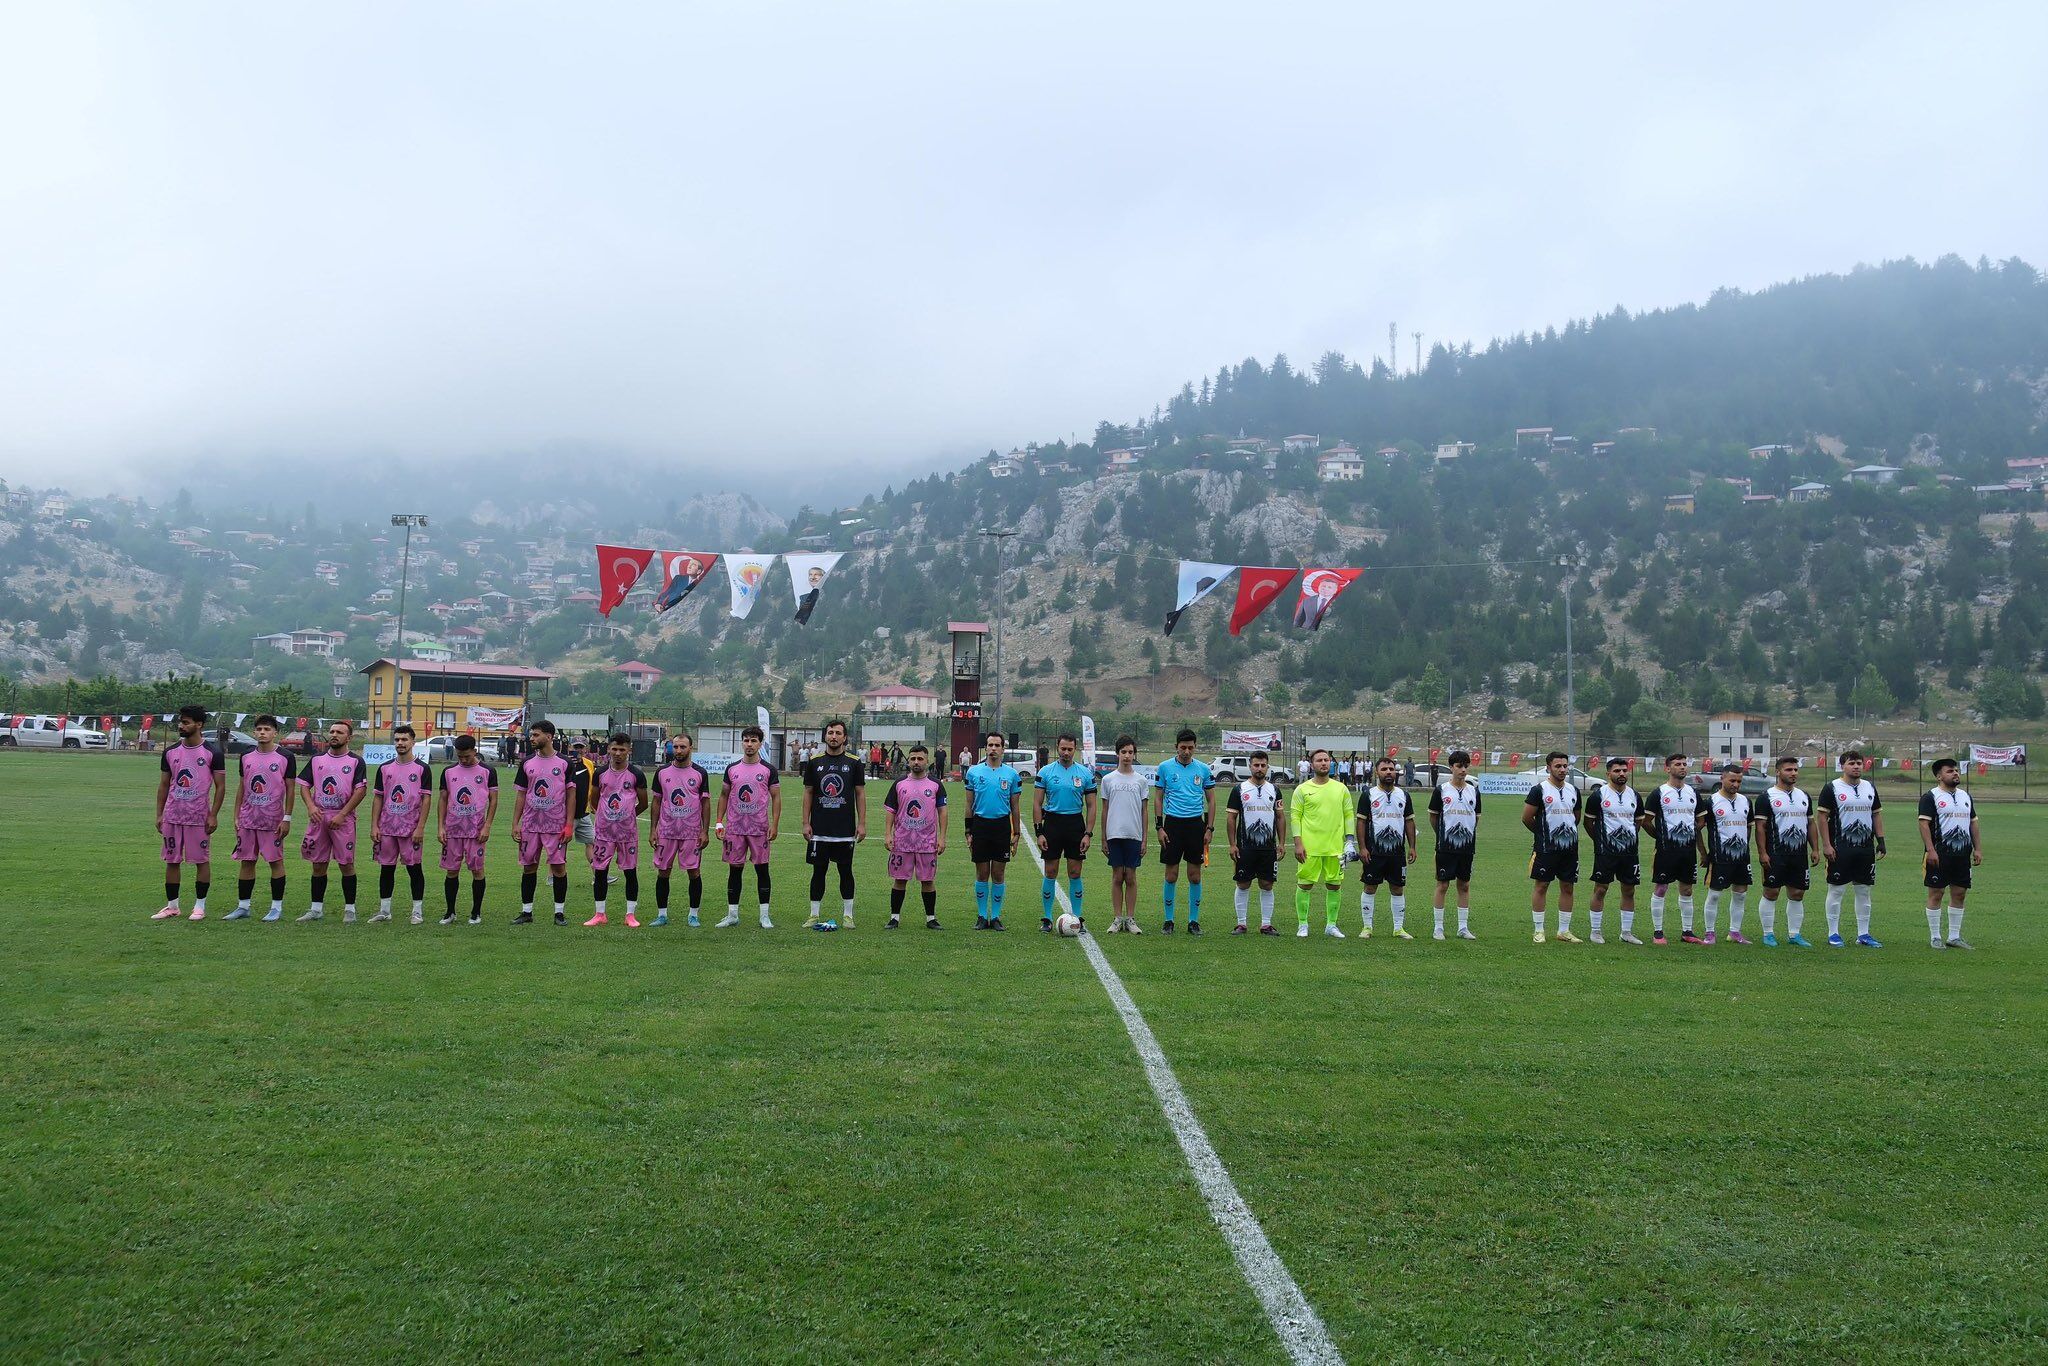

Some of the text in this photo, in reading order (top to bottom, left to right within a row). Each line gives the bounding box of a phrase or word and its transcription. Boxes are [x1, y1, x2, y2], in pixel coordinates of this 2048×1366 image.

[164, 836, 176, 849] 18
[302, 837, 315, 849] 52
[593, 845, 606, 858] 22
[890, 853, 903, 866] 23
